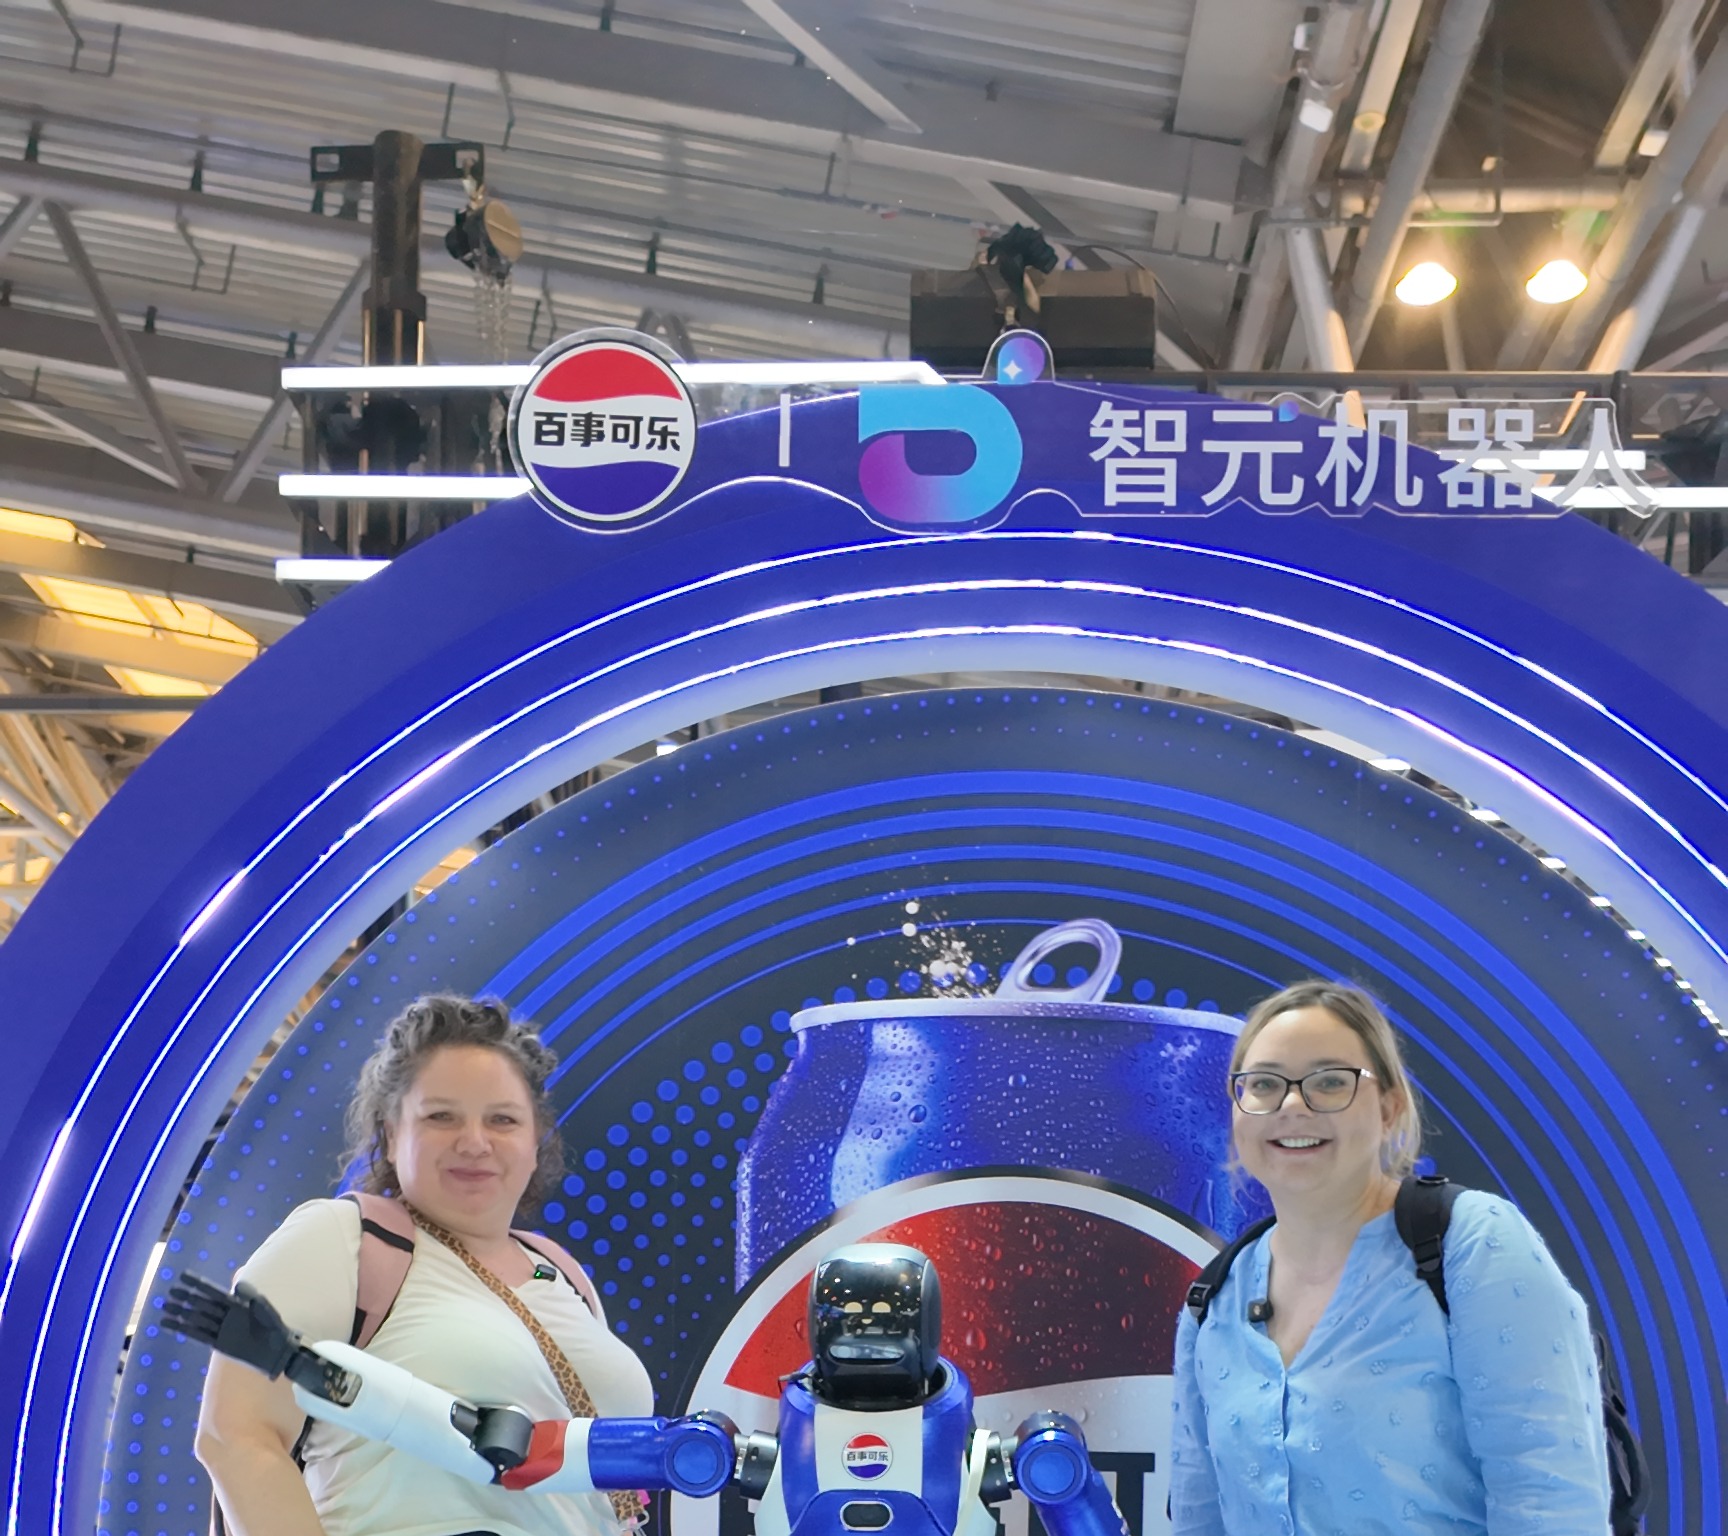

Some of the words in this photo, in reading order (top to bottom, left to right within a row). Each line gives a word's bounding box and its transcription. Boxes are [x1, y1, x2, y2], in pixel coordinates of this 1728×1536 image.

[532, 410, 681, 452] 百事可乐
[1088, 400, 1654, 509] 智元机器人
[846, 1451, 889, 1462] 百事可乐
